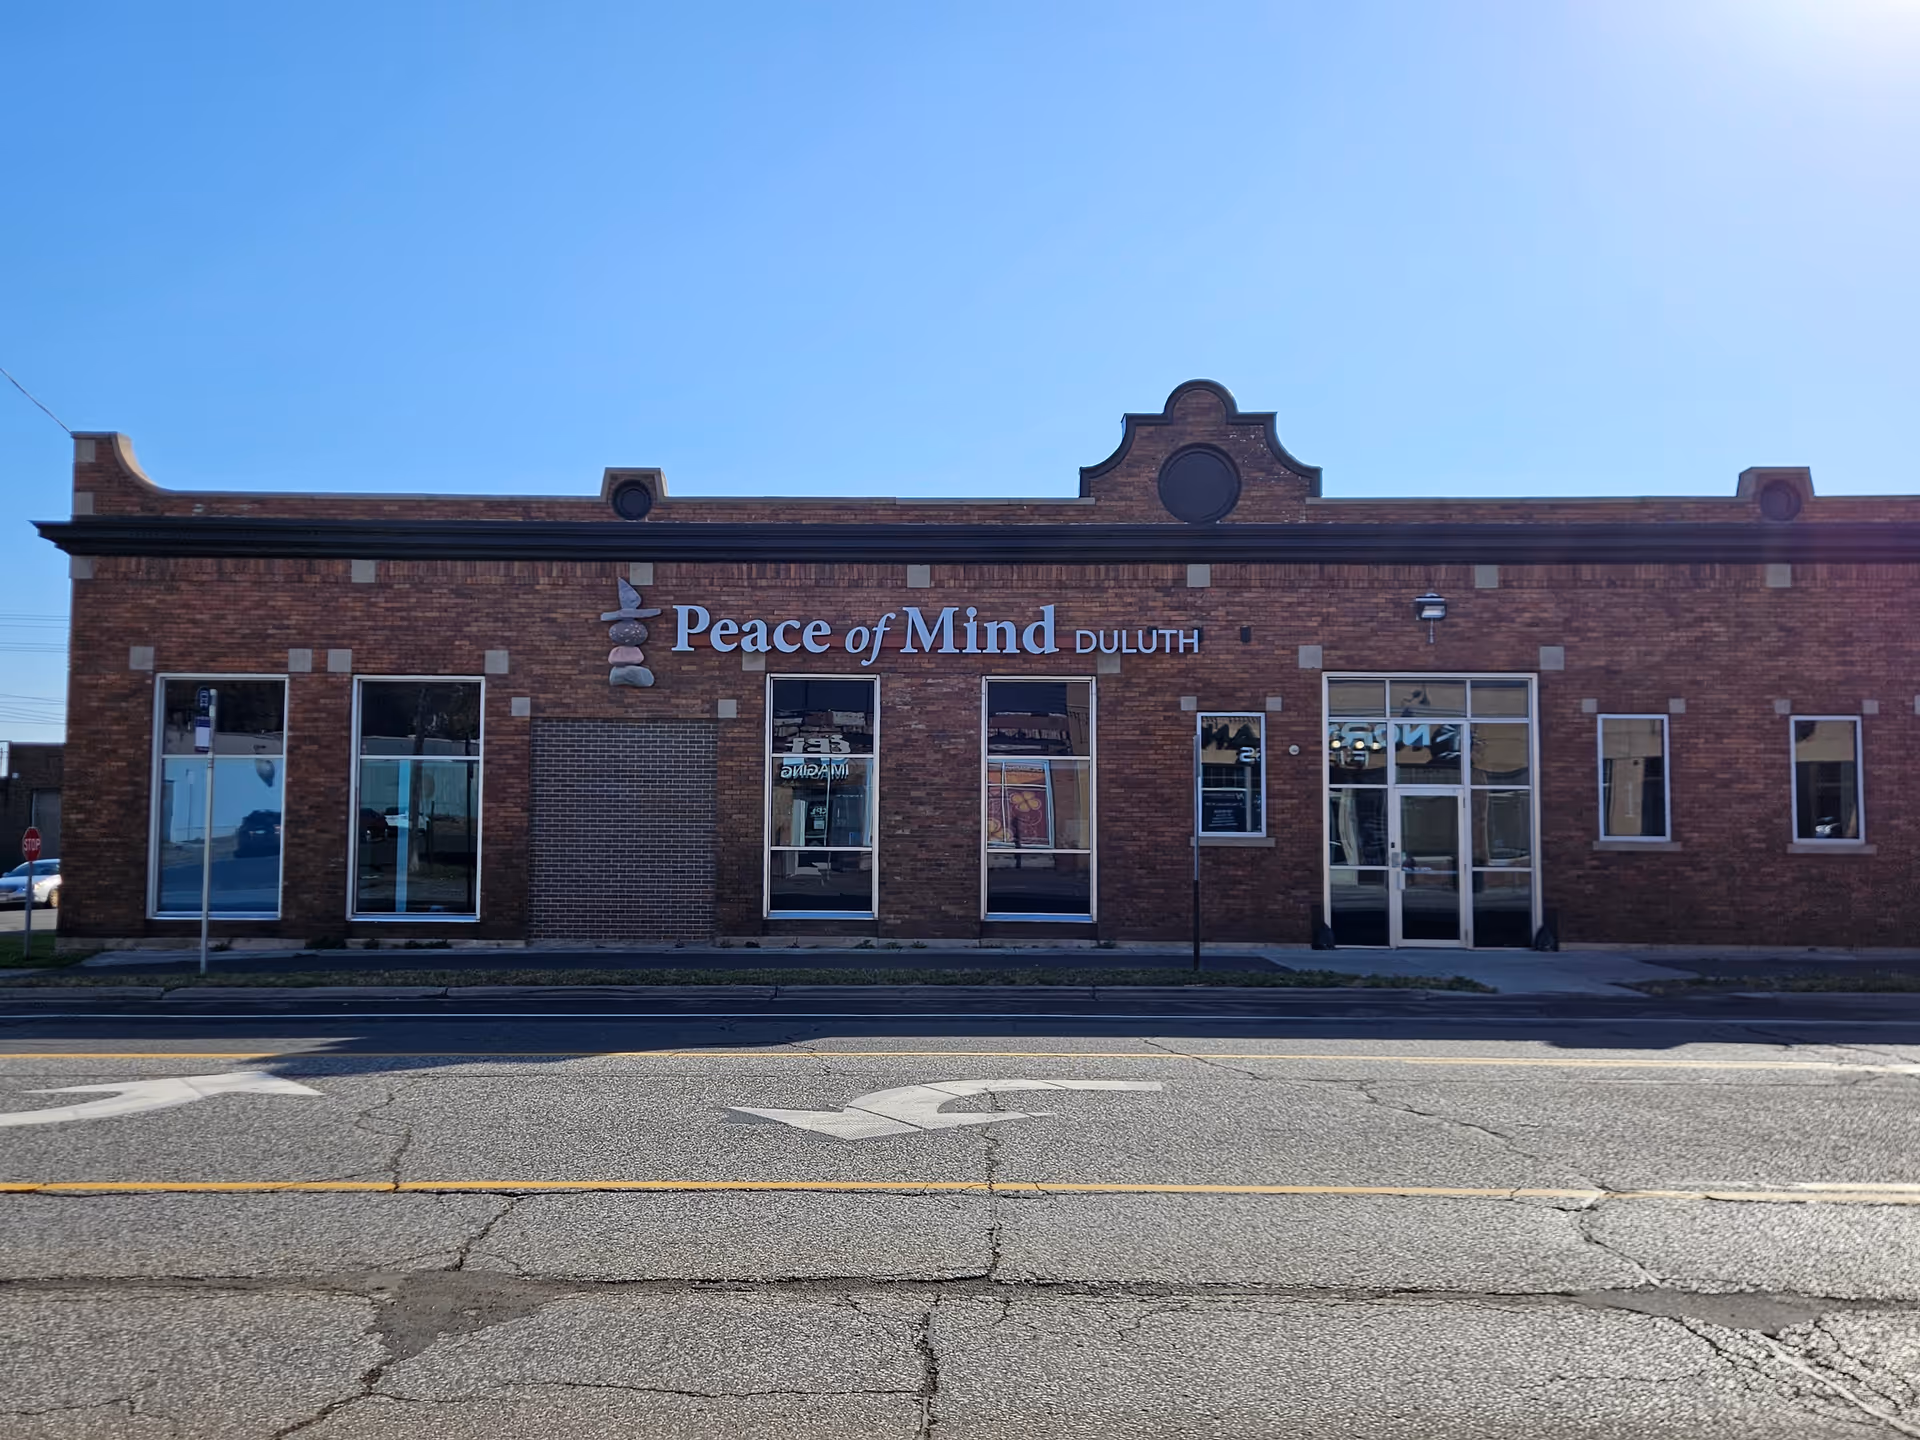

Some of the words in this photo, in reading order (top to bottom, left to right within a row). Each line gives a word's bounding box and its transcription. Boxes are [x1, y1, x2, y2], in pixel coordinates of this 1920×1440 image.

[671, 604, 832, 654] Peace
[844, 612, 896, 666] of
[902, 603, 1060, 655] Mind
[1076, 628, 1200, 655] DULUTH
[23, 837, 41, 852] STOP
